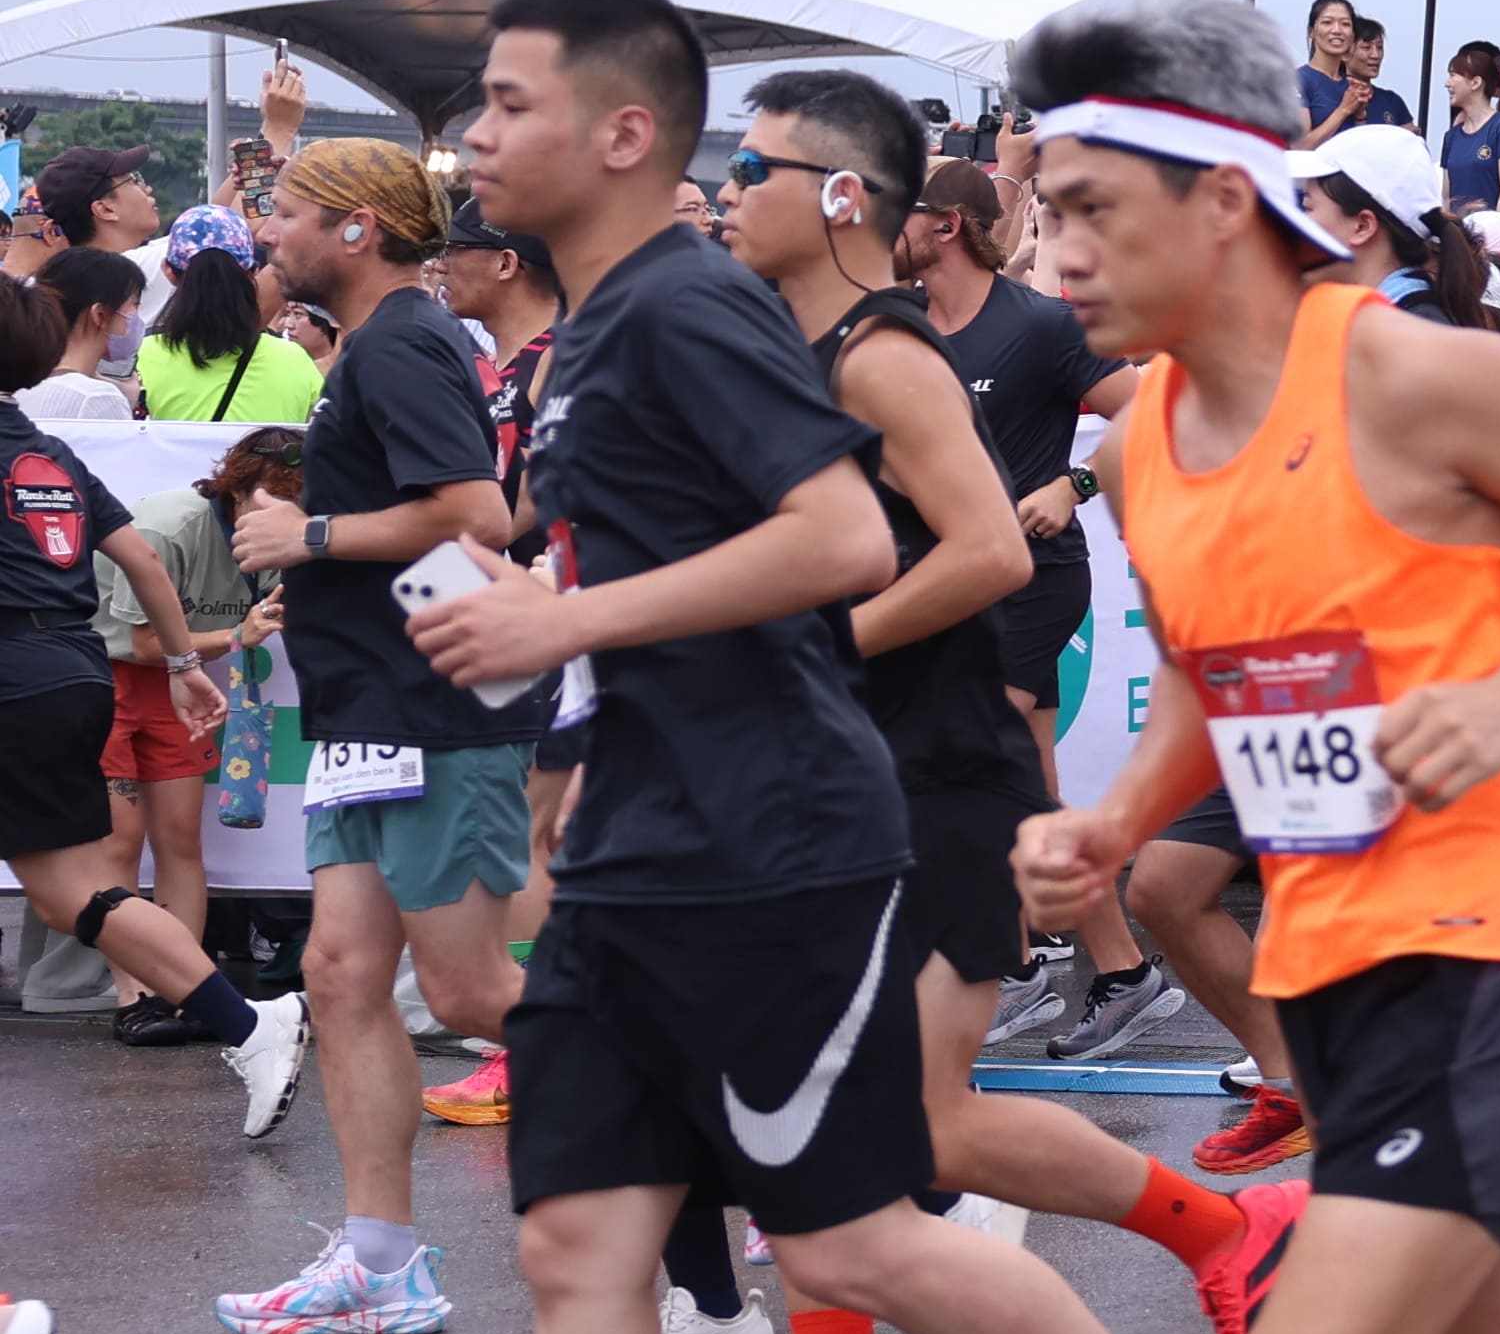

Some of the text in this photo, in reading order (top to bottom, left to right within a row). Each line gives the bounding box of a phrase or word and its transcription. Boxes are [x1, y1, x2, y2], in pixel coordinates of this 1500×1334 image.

[15, 489, 44, 501] Rock
[51, 490, 75, 502] Roll
[196, 598, 252, 617] olumb
[1238, 724, 1362, 789] 1148
